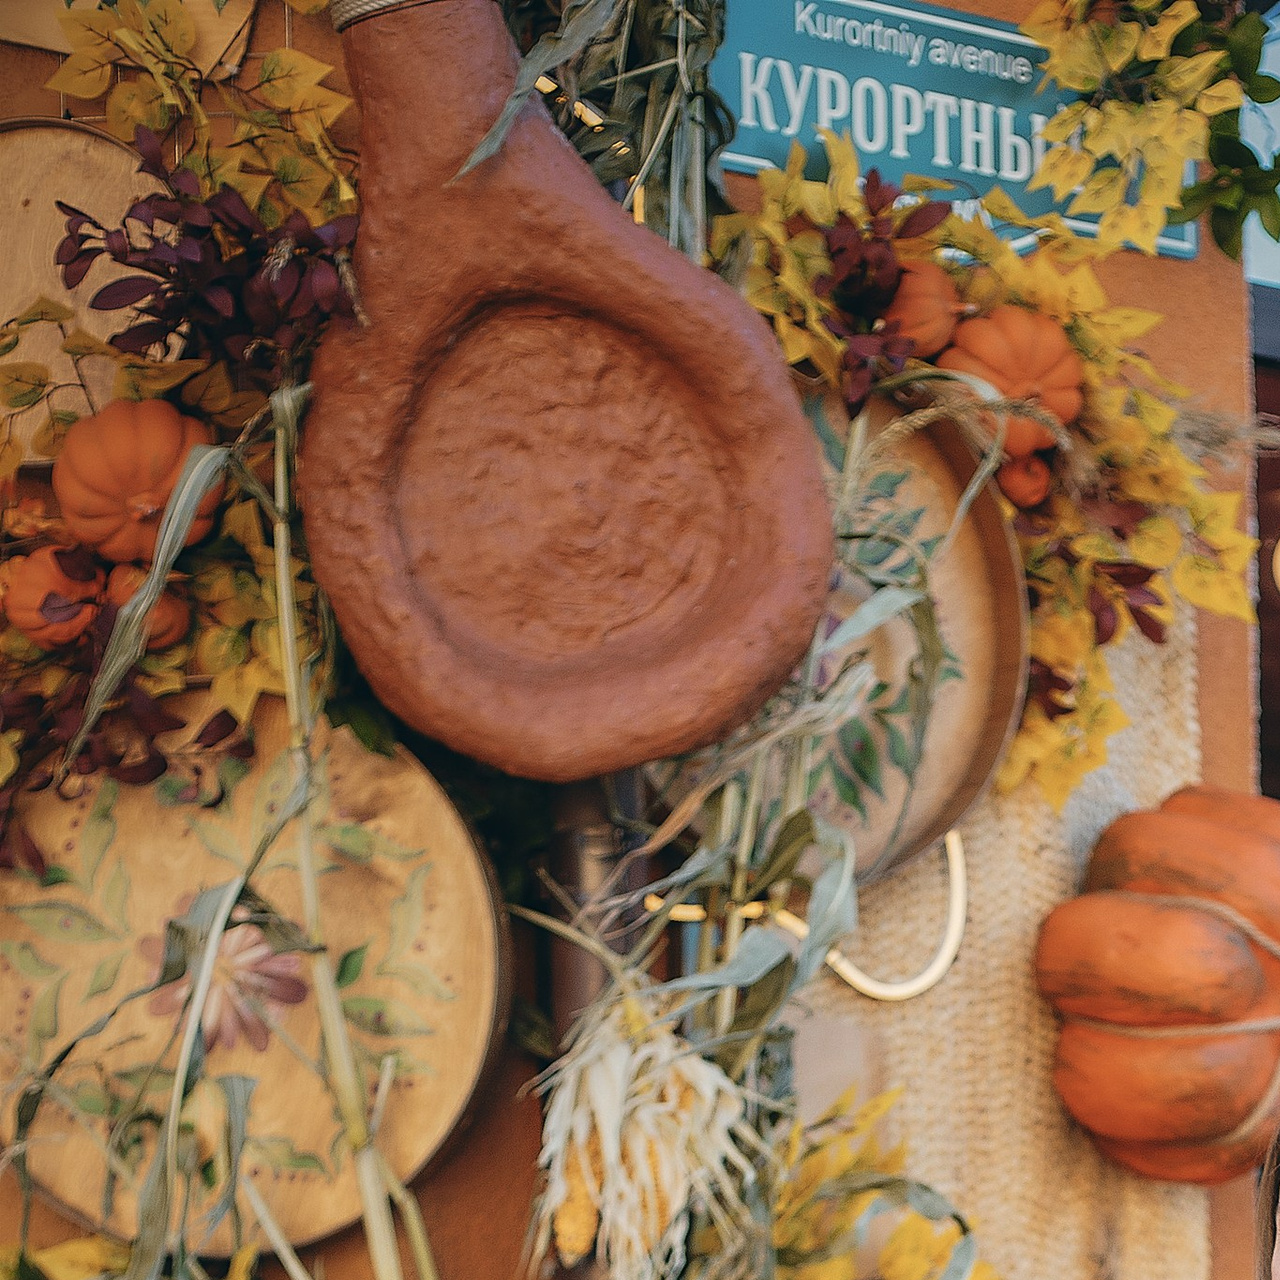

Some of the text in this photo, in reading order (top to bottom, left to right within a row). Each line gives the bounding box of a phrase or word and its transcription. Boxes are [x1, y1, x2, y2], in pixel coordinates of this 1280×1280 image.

[794, 0, 1033, 84] Kurortniy avenue
[737, 52, 1085, 183] КУРОРТНЫ
